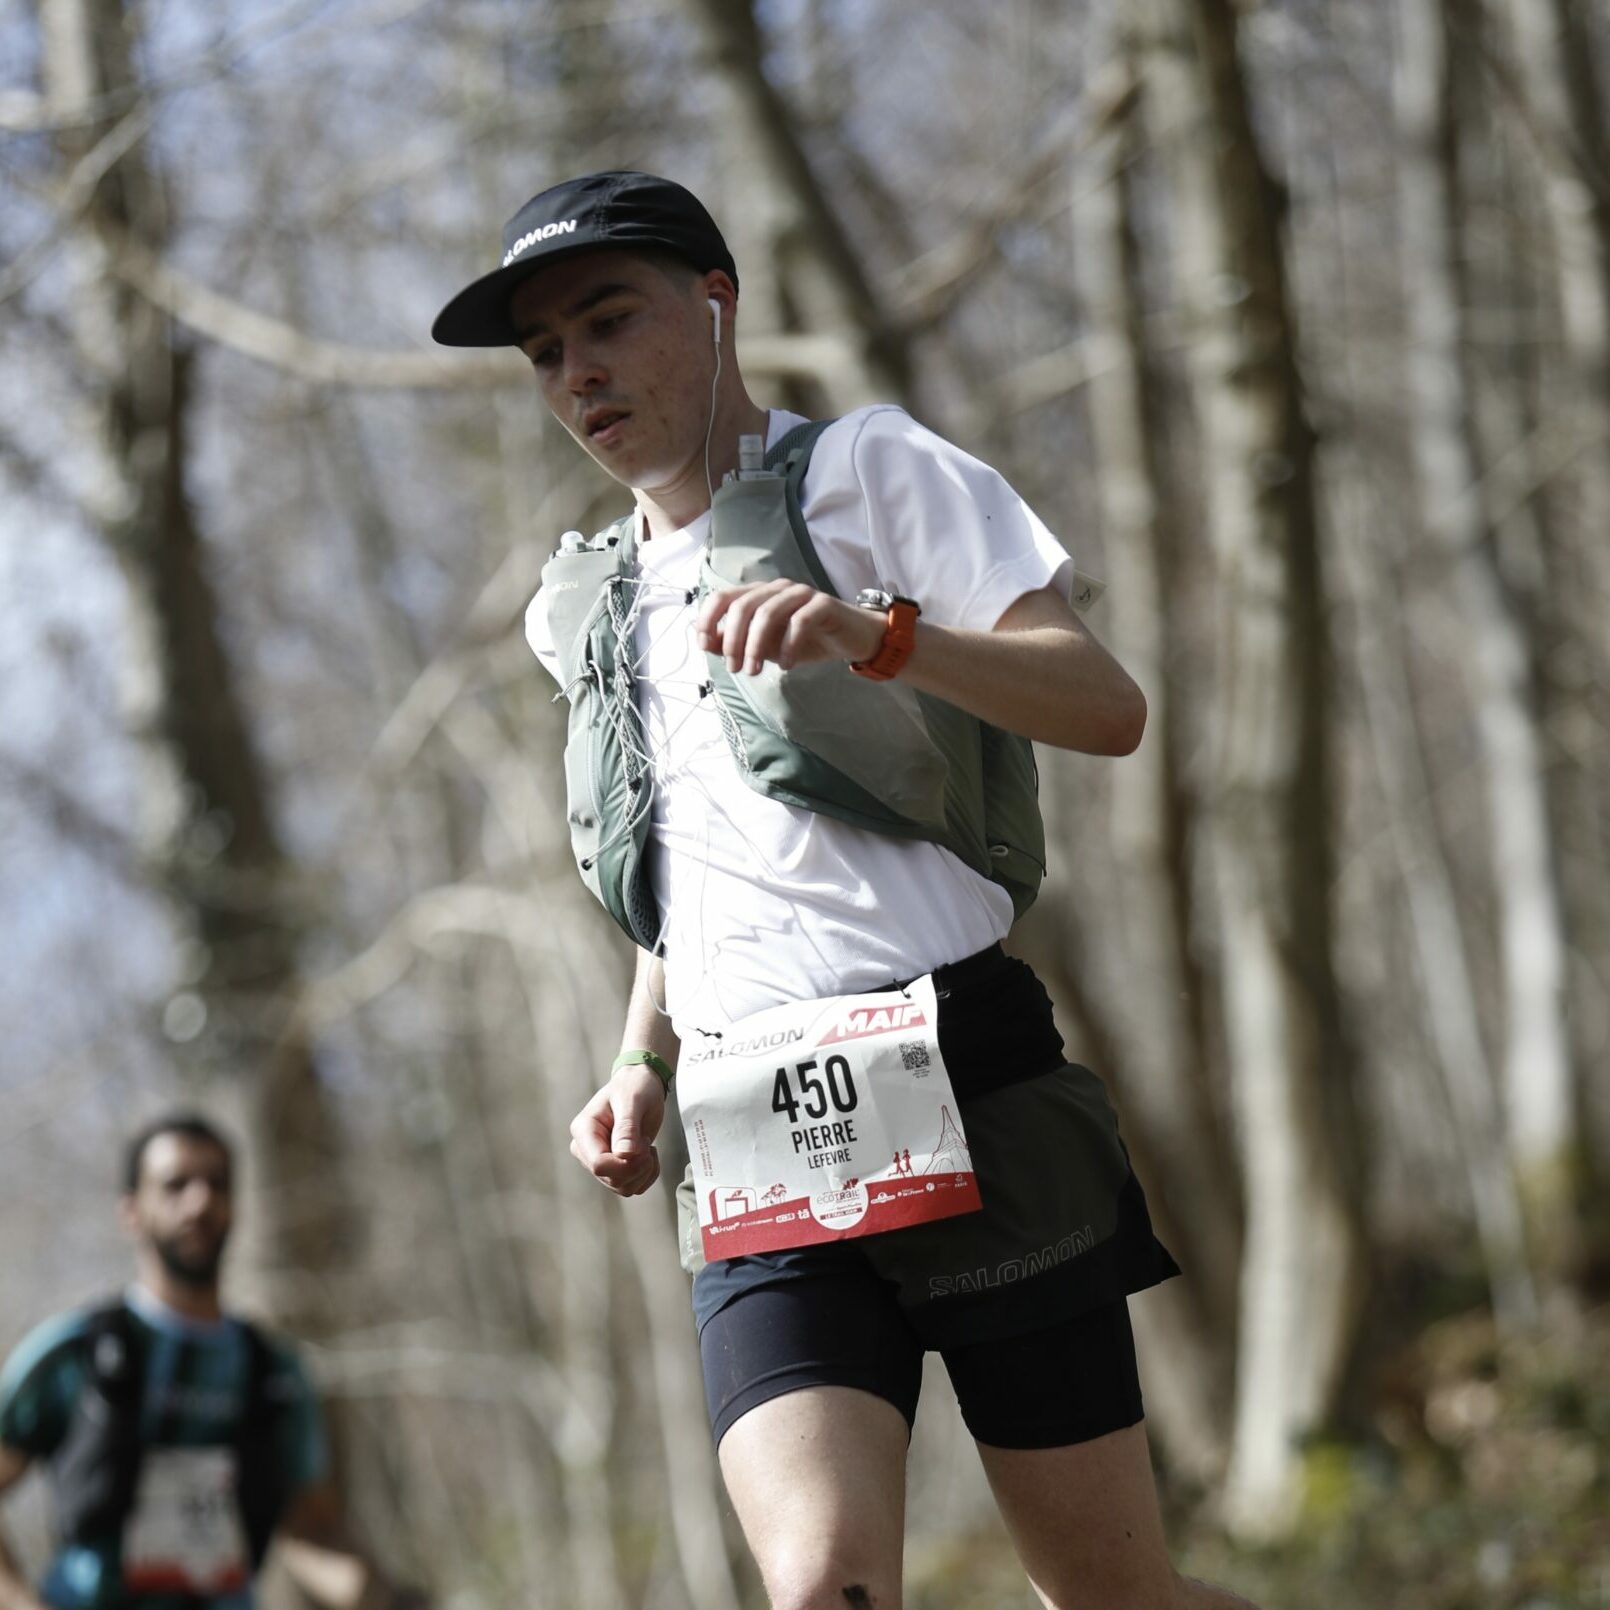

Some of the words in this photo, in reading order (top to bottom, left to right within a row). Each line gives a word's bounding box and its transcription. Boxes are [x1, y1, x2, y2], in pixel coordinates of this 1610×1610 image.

[837, 1005, 923, 1037] MAIF
[772, 1055, 858, 1123] 450
[791, 1119, 858, 1154] PIERRE
[807, 1148, 852, 1169] LEFEVRE
[929, 1225, 1095, 1299] SALOMON
